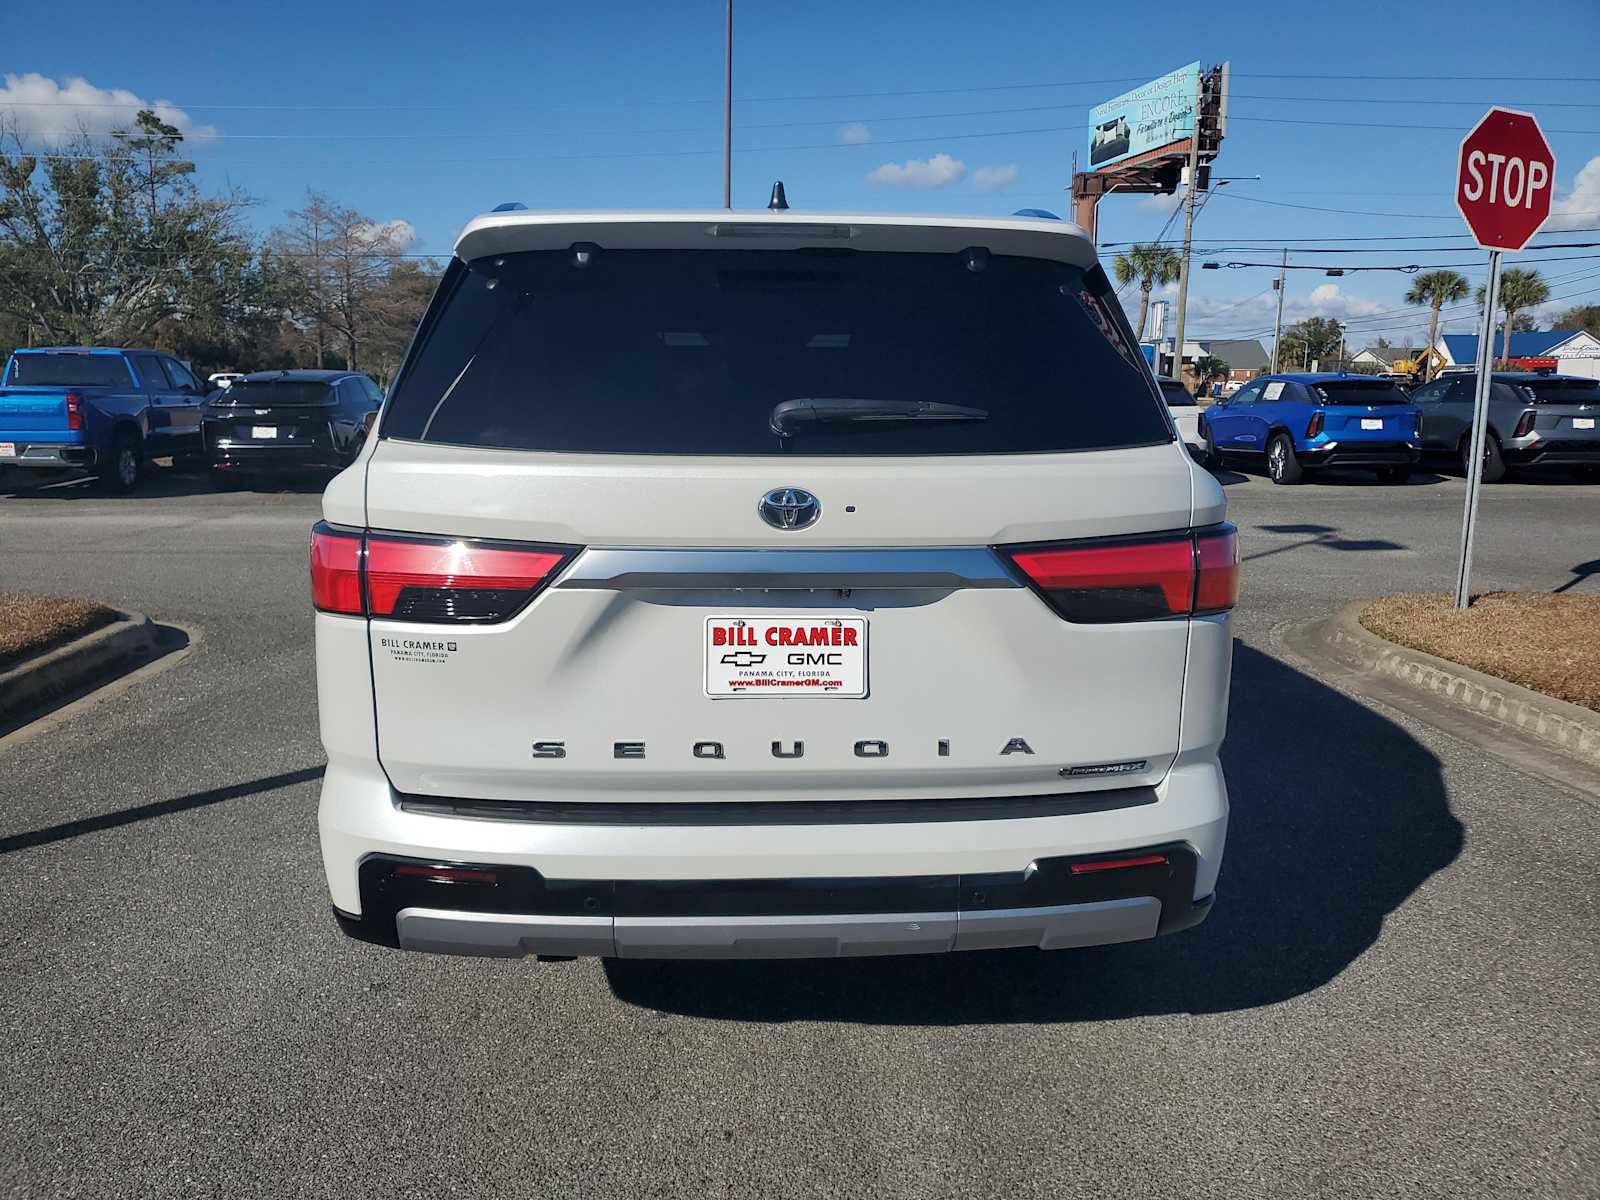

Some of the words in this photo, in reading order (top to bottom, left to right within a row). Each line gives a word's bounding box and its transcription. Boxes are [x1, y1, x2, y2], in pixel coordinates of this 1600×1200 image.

[1464, 150, 1548, 209] STOP
[381, 638, 400, 648] BILL
[403, 640, 444, 650] CRAMER
[713, 627, 757, 646] BILL
[765, 627, 858, 646] CRAMER
[787, 653, 842, 665] GMC
[728, 679, 842, 687] www.BillCramerGM.com
[532, 738, 1036, 759] SEQUOIA
